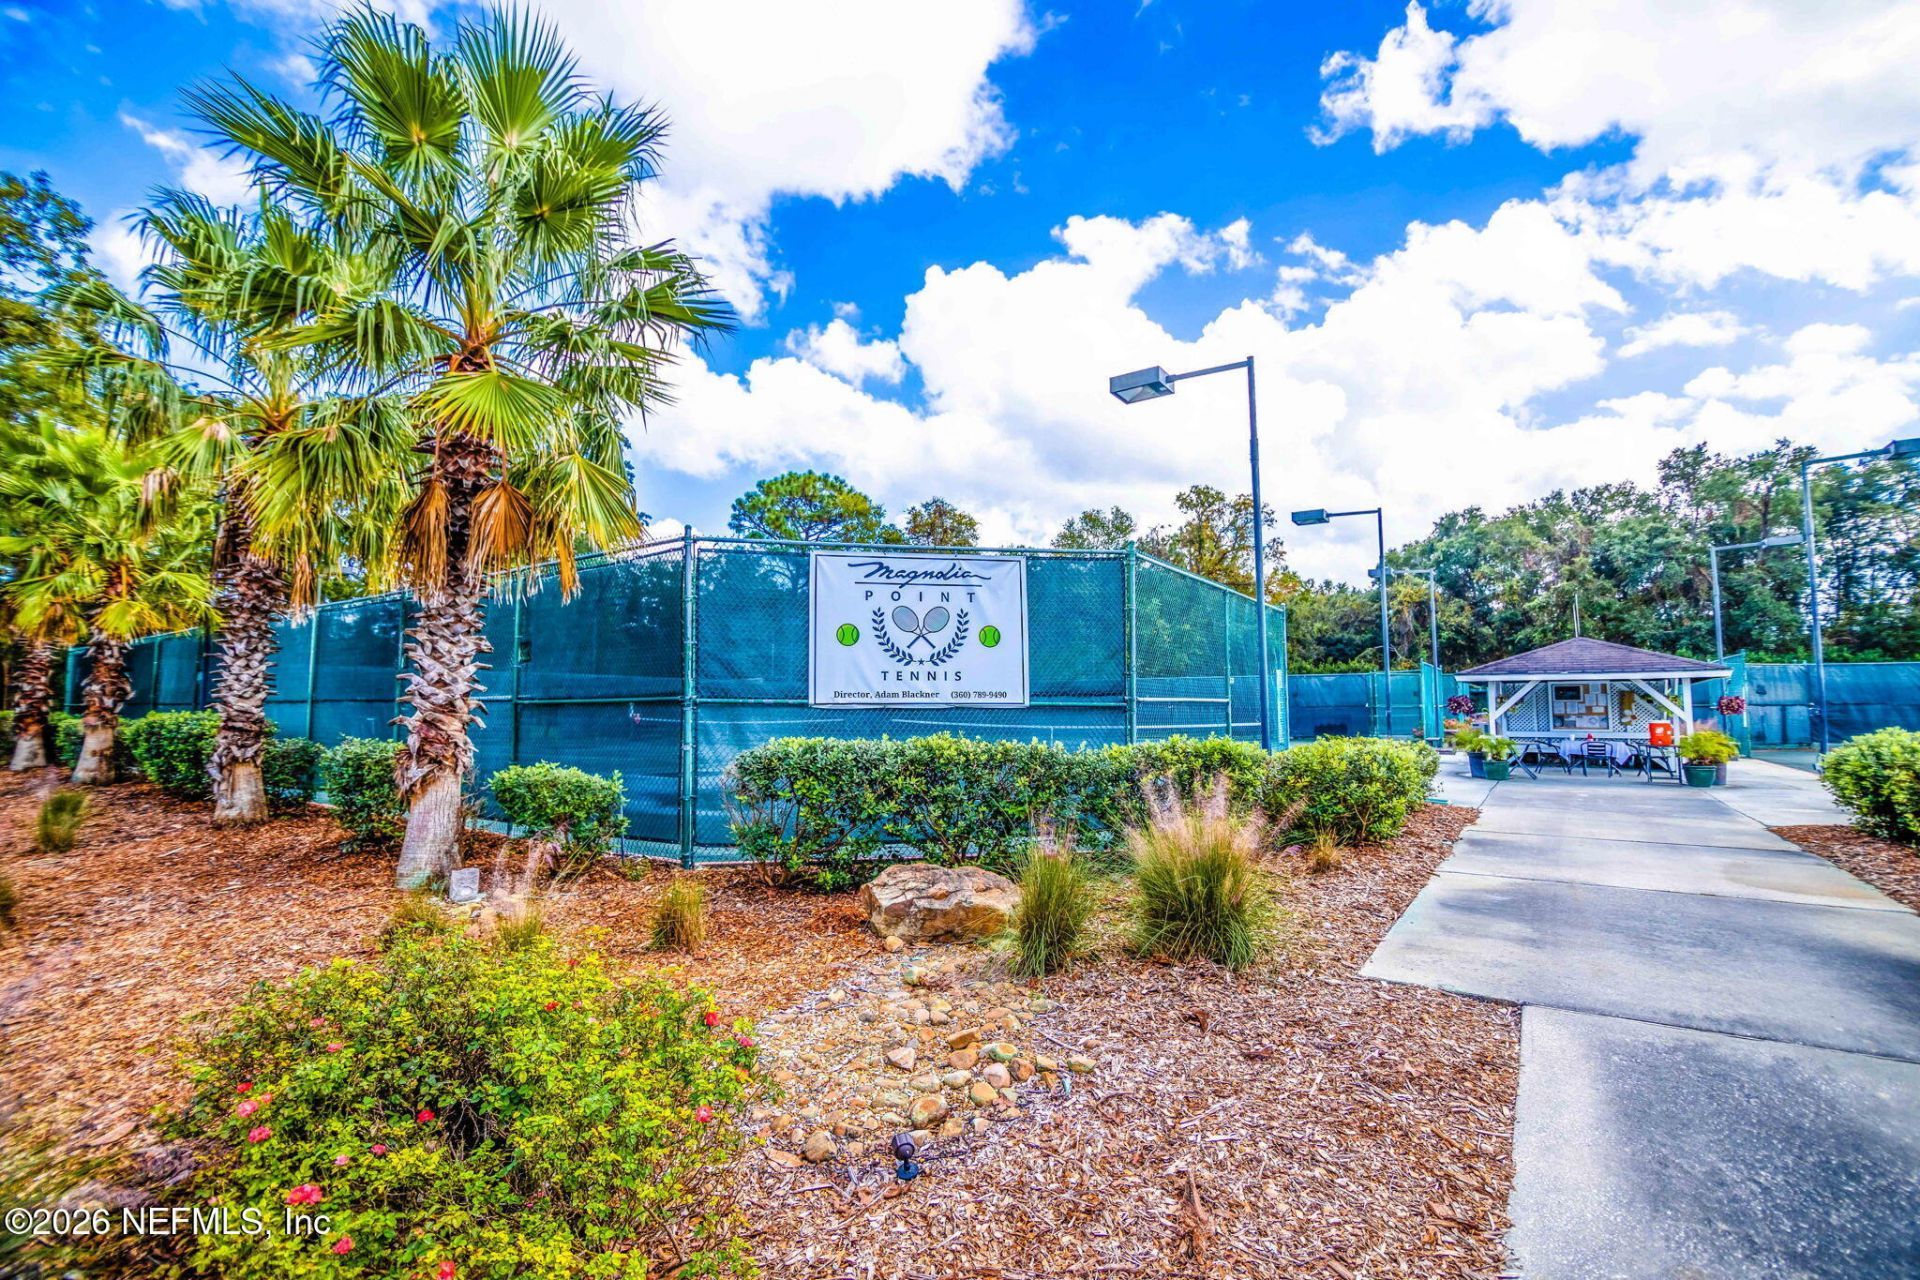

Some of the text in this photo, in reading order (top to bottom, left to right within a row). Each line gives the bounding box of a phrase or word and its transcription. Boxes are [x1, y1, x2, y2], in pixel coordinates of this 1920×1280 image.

[847, 561, 991, 589] Magnolia
[865, 590, 975, 603] POINT
[881, 670, 962, 681] TENNIS
[833, 690, 1007, 699] Director, Adam Blackner (360) 789-9490
